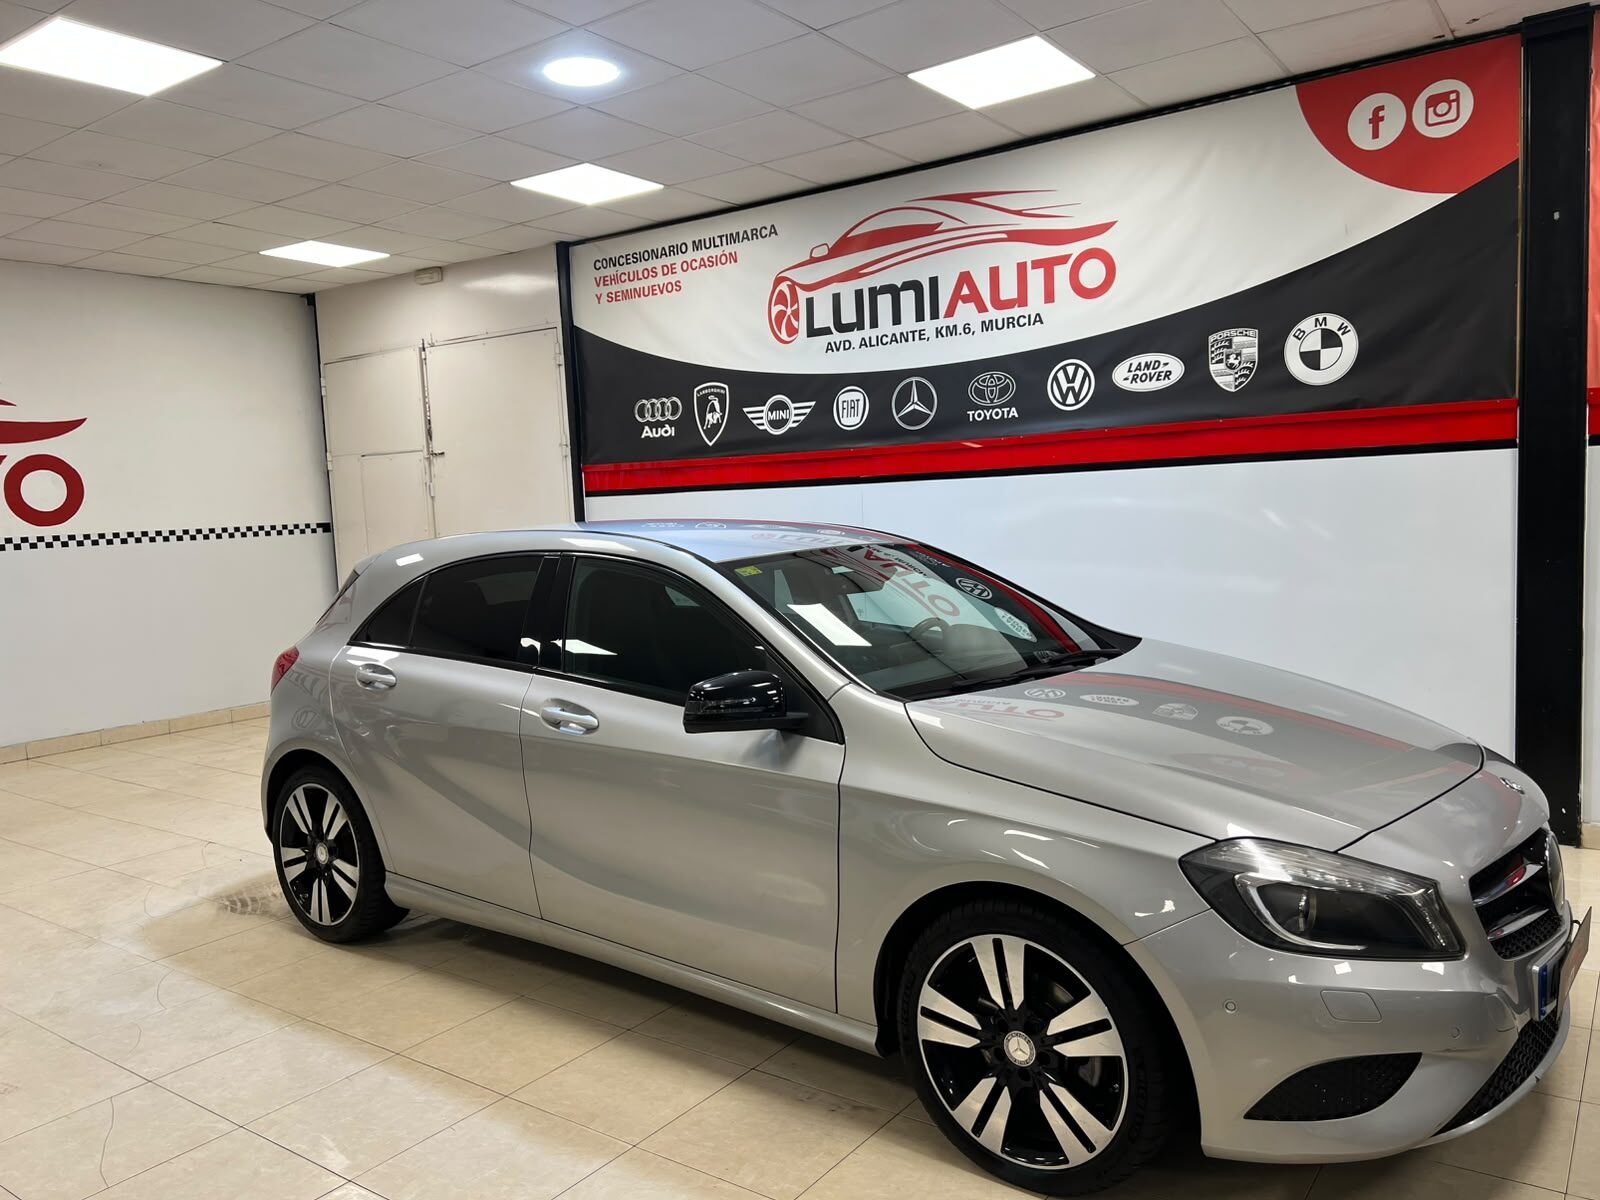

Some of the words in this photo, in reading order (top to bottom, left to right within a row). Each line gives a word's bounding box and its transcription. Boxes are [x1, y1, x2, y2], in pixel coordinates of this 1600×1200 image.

[593, 241, 688, 271] CONCESIONARIO
[691, 223, 779, 253] MULTIMARCA
[594, 264, 658, 288] VEHÍCULOS
[661, 262, 677, 276] DE
[680, 249, 738, 274] OCASIÓN
[595, 293, 602, 304] Y
[606, 279, 682, 304] SEMINUEVOS
[825, 339, 856, 354] AVD.
[858, 328, 931, 349] ALICANTE,
[935, 323, 976, 339] KM.6,
[980, 312, 1044, 334] MURCIA
[1210, 330, 1256, 341] PORSCHE
[1293, 316, 1351, 341] BMW
[767, 408, 790, 422] MINI
[841, 398, 862, 420] FIAT
[967, 407, 1019, 422] TOYOTA
[641, 424, 675, 439] Audi
